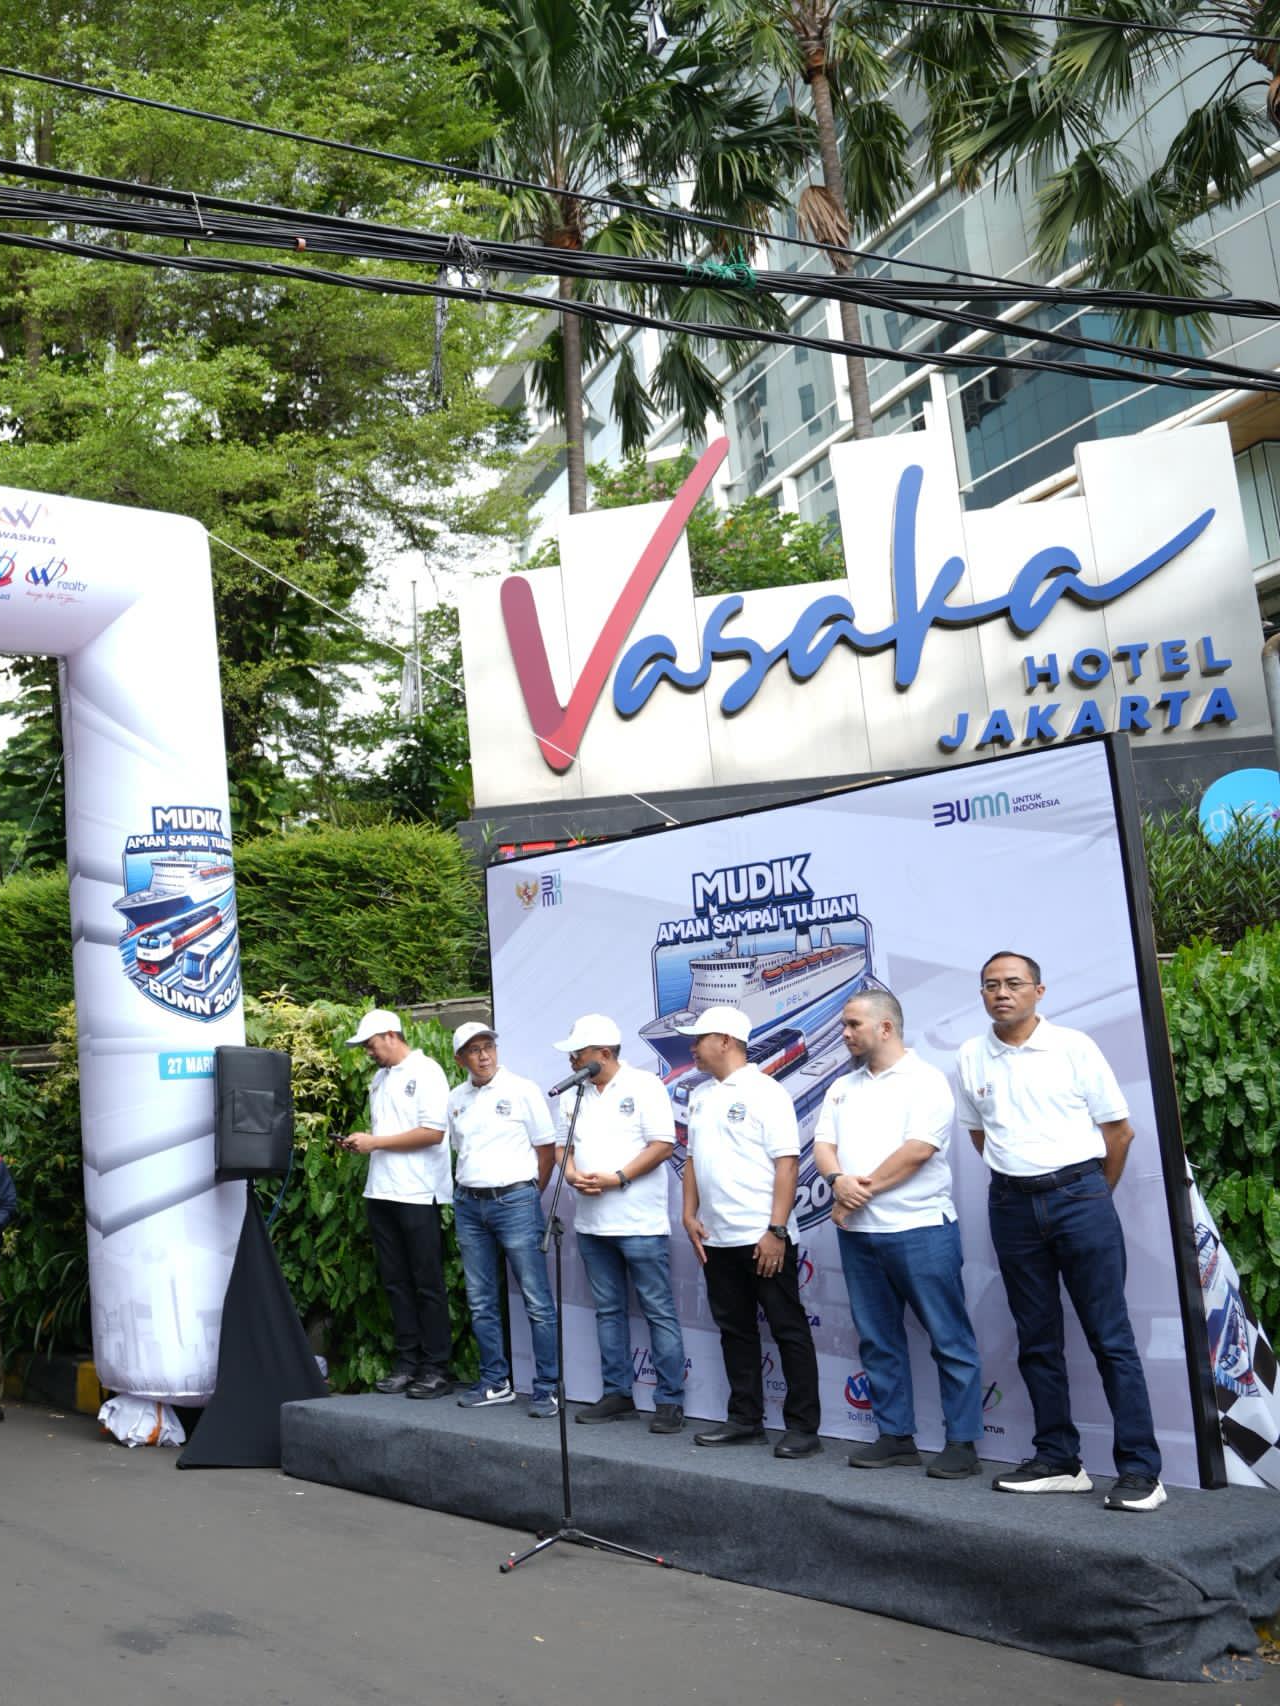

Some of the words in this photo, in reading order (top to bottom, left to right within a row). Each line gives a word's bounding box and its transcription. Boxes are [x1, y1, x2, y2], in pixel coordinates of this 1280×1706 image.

[57, 581, 88, 592] realty
[500, 437, 1217, 773] Vasaka
[1023, 636, 1233, 693] HOTEL
[939, 687, 1239, 750] JAKARTA
[1013, 793, 1042, 804] UNTUK
[1013, 799, 1060, 813] INDONESIA
[154, 808, 223, 832] MUDIK
[127, 835, 166, 849] AMAN
[168, 834, 209, 848] SAMPAI
[694, 857, 808, 909] MUDIK
[658, 919, 710, 943] AMAN
[712, 907, 779, 933] SAMPAI
[783, 896, 858, 923] TUJUAN
[149, 978, 211, 1015] BUMN
[167, 1057, 183, 1075] 27
[793, 1176, 832, 1217] 20
